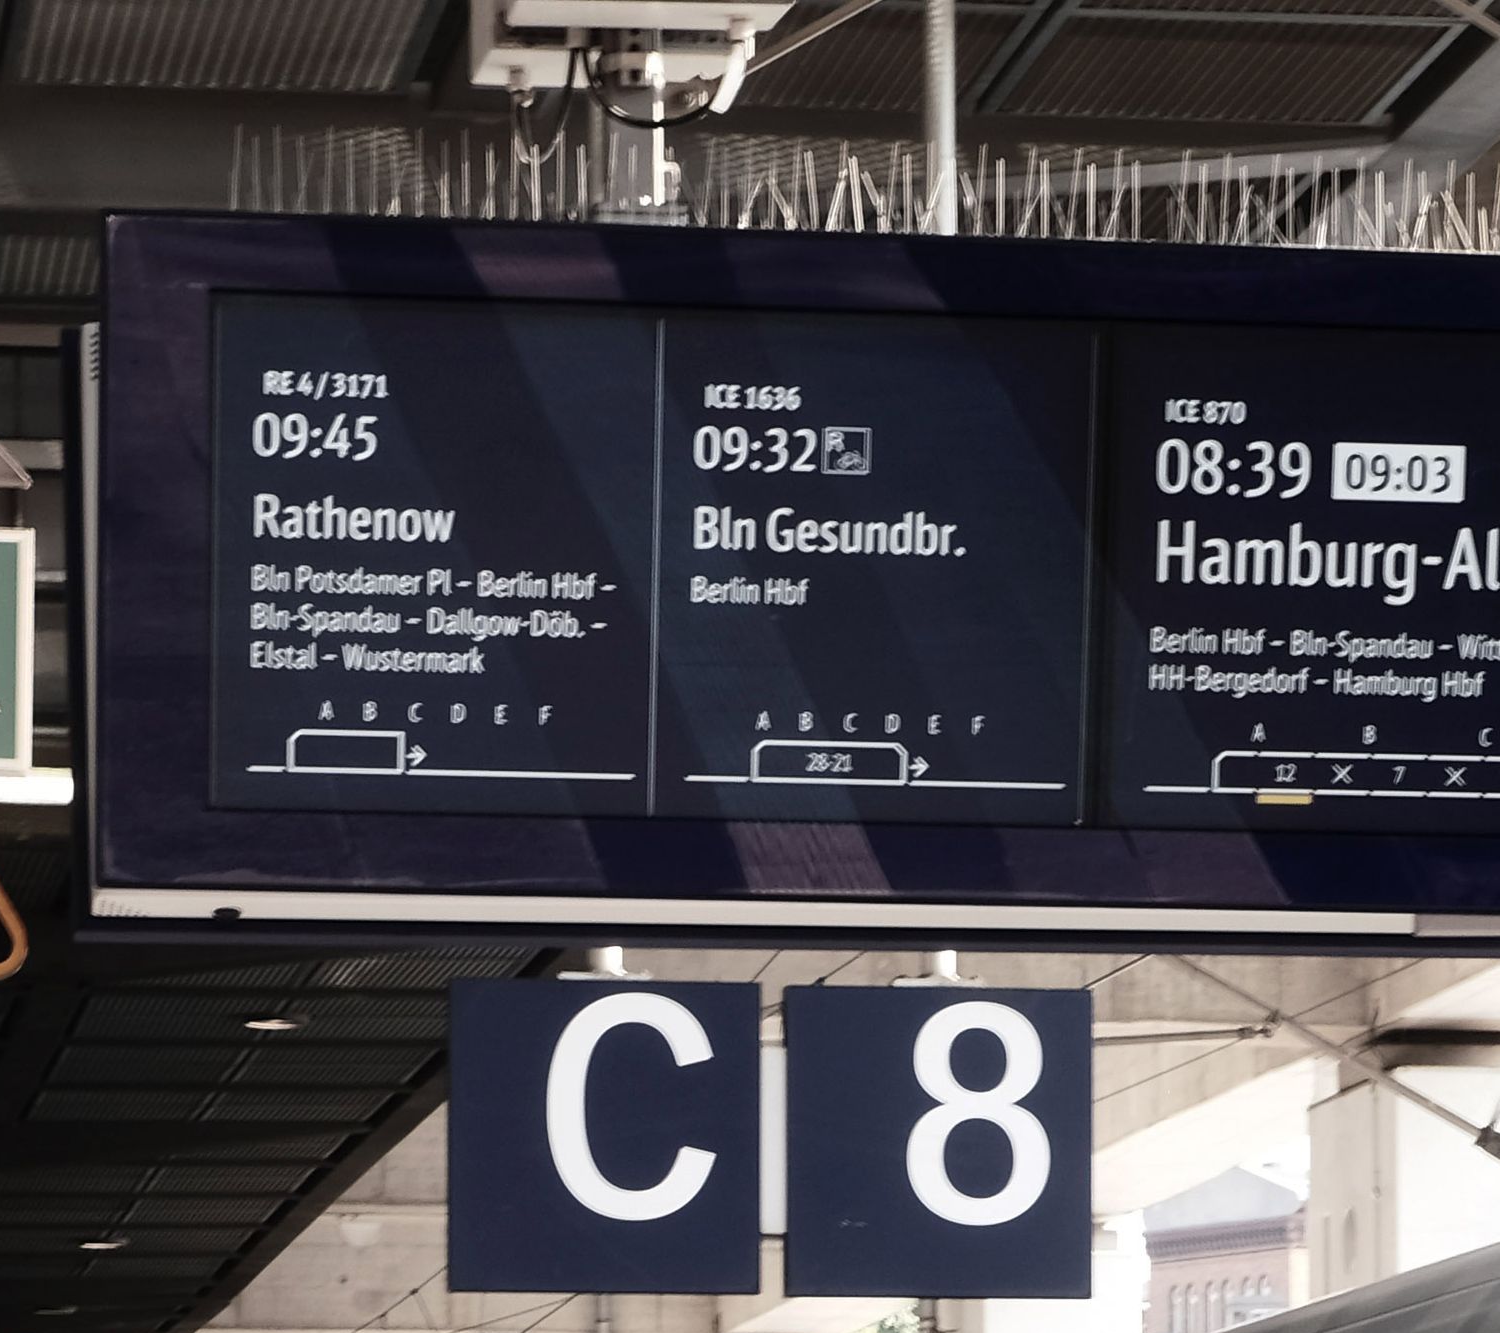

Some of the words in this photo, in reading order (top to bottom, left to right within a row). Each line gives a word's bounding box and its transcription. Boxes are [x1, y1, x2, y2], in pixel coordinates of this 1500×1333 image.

[703, 383, 741, 408] ICE
[744, 385, 802, 411] 1636
[1164, 398, 1201, 423] ICE
[1202, 401, 1248, 425] 870
[251, 412, 378, 462] 09:45
[693, 425, 818, 473] 09:32
[1156, 438, 1312, 500] 08:39
[1345, 452, 1453, 494] 09:03
[252, 492, 456, 545] Rathenow
[694, 505, 757, 551] Bln
[766, 507, 967, 557] Gesundbr.
[250, 564, 291, 592] Bln
[294, 565, 423, 596] Potsdamer
[426, 568, 453, 596] Pl
[477, 569, 548, 599] Berlin
[551, 571, 598, 600] Hbf
[690, 576, 761, 604] Berlin
[764, 578, 809, 607] Hbf
[250, 602, 401, 638] Bln-Spandau
[426, 606, 586, 642] Dallgow-Döb.
[249, 640, 318, 669] Elstal
[341, 643, 485, 674] Wustermark
[1149, 626, 1218, 654] Berlin
[1221, 628, 1266, 656] Hbf
[1289, 630, 1434, 662] Bln-Spandau
[1148, 664, 1310, 699] HH-Bergedorf
[1333, 667, 1438, 702] Hamburg
[1441, 670, 1485, 698] Hbf
[318, 701, 335, 722] A
[362, 701, 379, 722] B
[407, 702, 424, 724] C
[450, 703, 468, 724] D
[493, 704, 510, 725] E
[537, 705, 553, 726] F
[755, 710, 771, 731] A
[798, 711, 814, 732] B
[843, 713, 859, 733] C
[884, 713, 902, 734] D
[927, 714, 942, 735] E
[971, 715, 986, 736] F
[1250, 722, 1267, 743] A
[1362, 724, 1377, 745] B
[1478, 727, 1493, 747] C
[1274, 763, 1298, 782] 12
[1392, 765, 1407, 784] 7
[546, 991, 717, 1221] C
[906, 1001, 1052, 1226] 8
